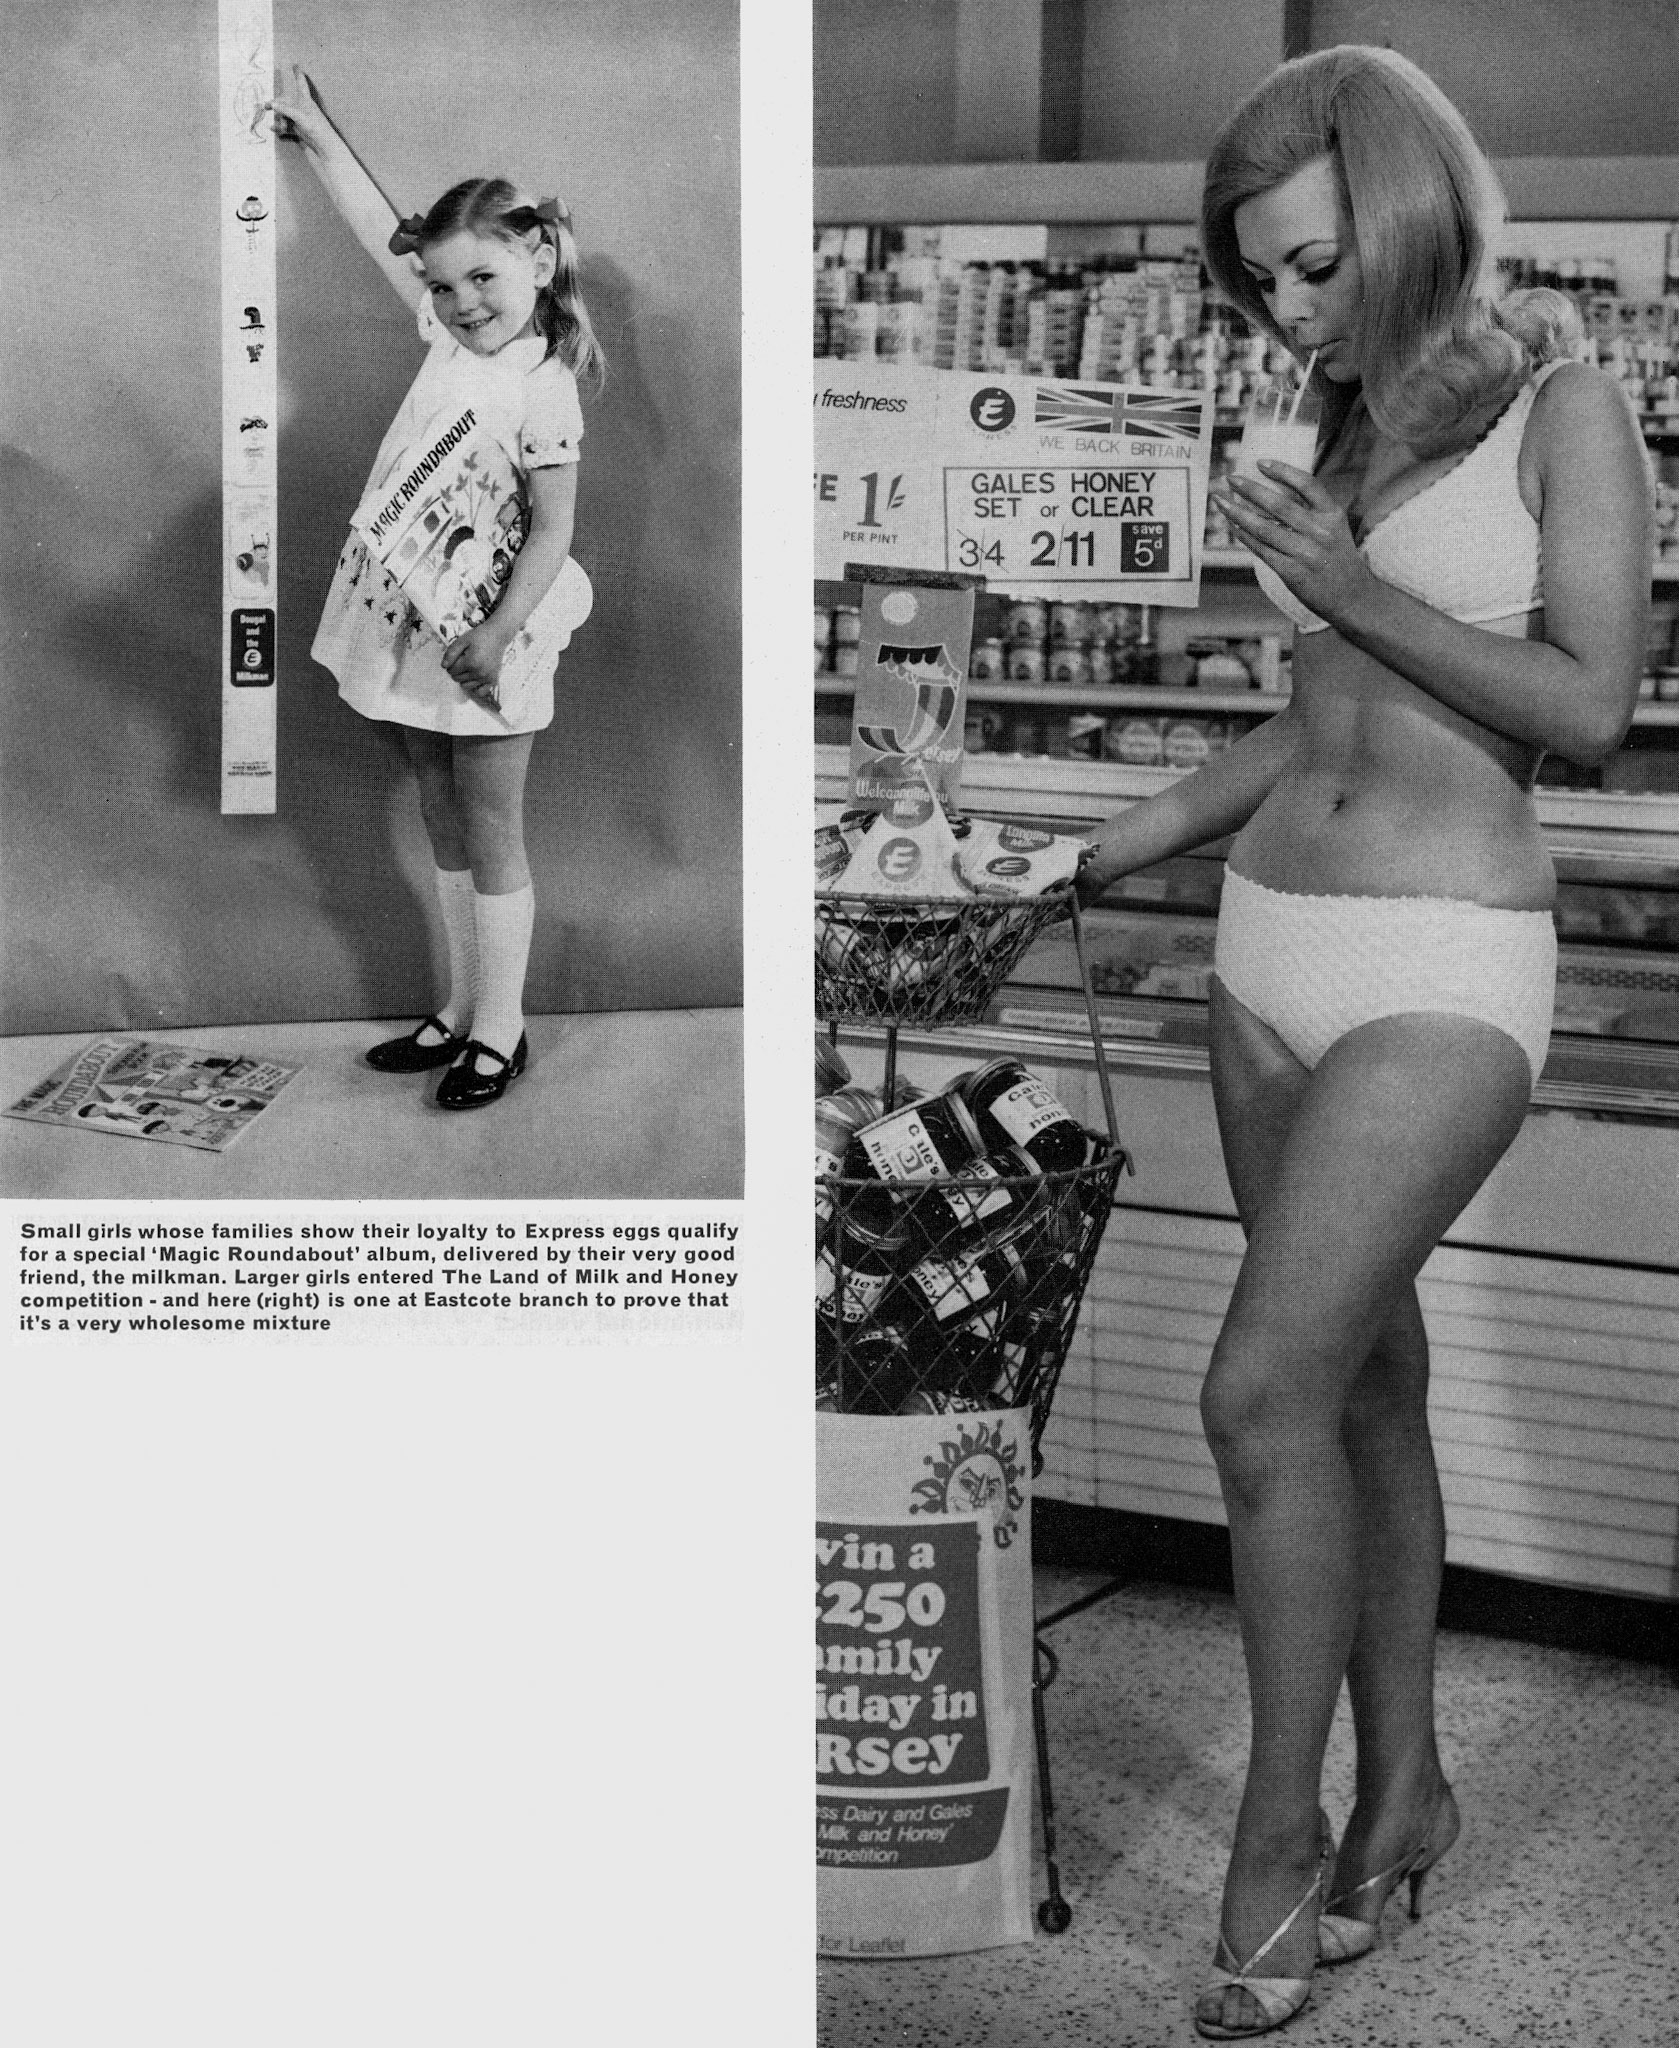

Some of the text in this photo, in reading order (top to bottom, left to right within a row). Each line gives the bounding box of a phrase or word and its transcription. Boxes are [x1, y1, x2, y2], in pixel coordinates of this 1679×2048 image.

[820, 388, 908, 413] freshness
[1038, 435, 1192, 460] WE BACK BRITAIN
[369, 407, 478, 547] MAGIC ROUNDABOUT
[970, 471, 1157, 495] GALES HONEY
[973, 495, 1156, 519] SET or CLEAR
[842, 530, 900, 545] PER PINT
[1131, 523, 1165, 536] save
[908, 1541, 936, 1570] a
[816, 1580, 946, 1634] 250
[931, 1683, 978, 1721] in
[842, 1804, 889, 1826] Dairy
[893, 1804, 926, 1822] and
[929, 1802, 974, 1820] Gales
[857, 1825, 893, 1843] and
[816, 1845, 900, 1865] ompetition
